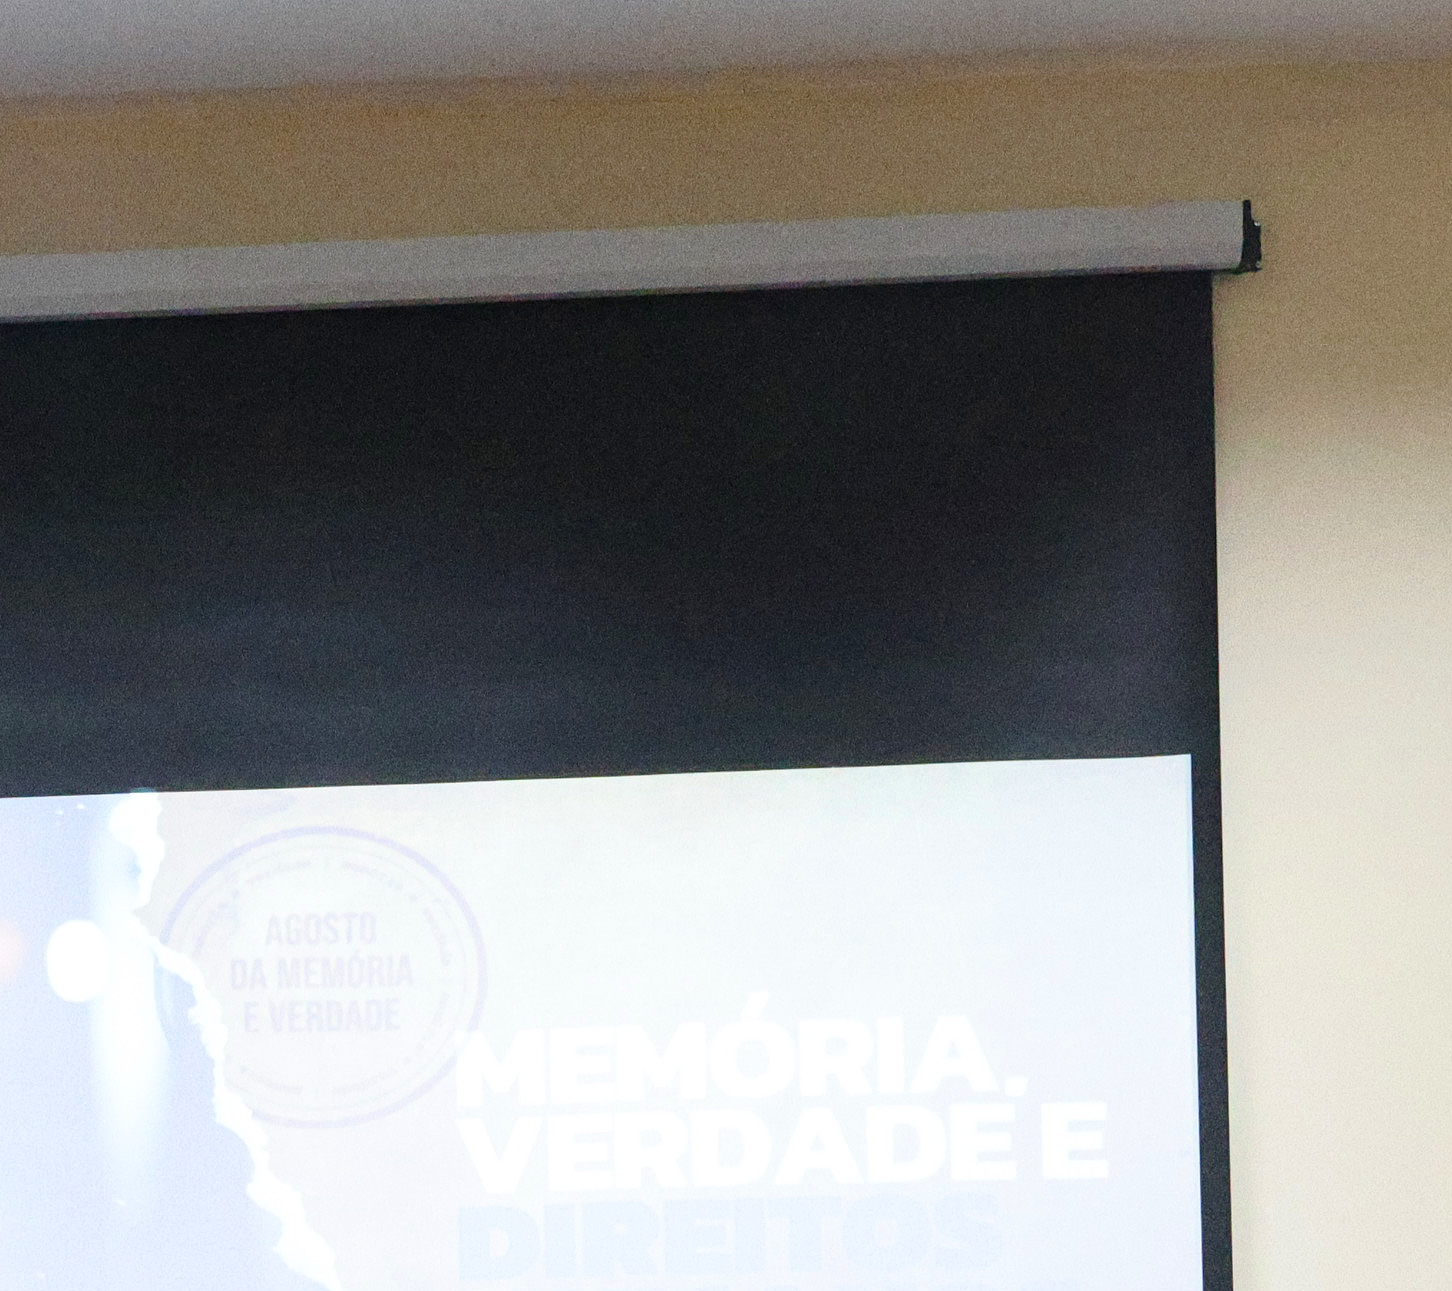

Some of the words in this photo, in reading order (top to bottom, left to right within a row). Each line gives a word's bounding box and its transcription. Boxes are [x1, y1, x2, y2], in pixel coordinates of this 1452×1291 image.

[266, 912, 377, 946] AGOSTO
[230, 958, 266, 991] DA
[276, 949, 413, 990] MEMÓRIA
[243, 1001, 259, 1033] E
[269, 998, 400, 1033] VERDADE
[456, 1104, 1016, 1194] VERDADE
[1042, 1102, 1109, 1179] E
[457, 1192, 1003, 1281] DIREITOS
